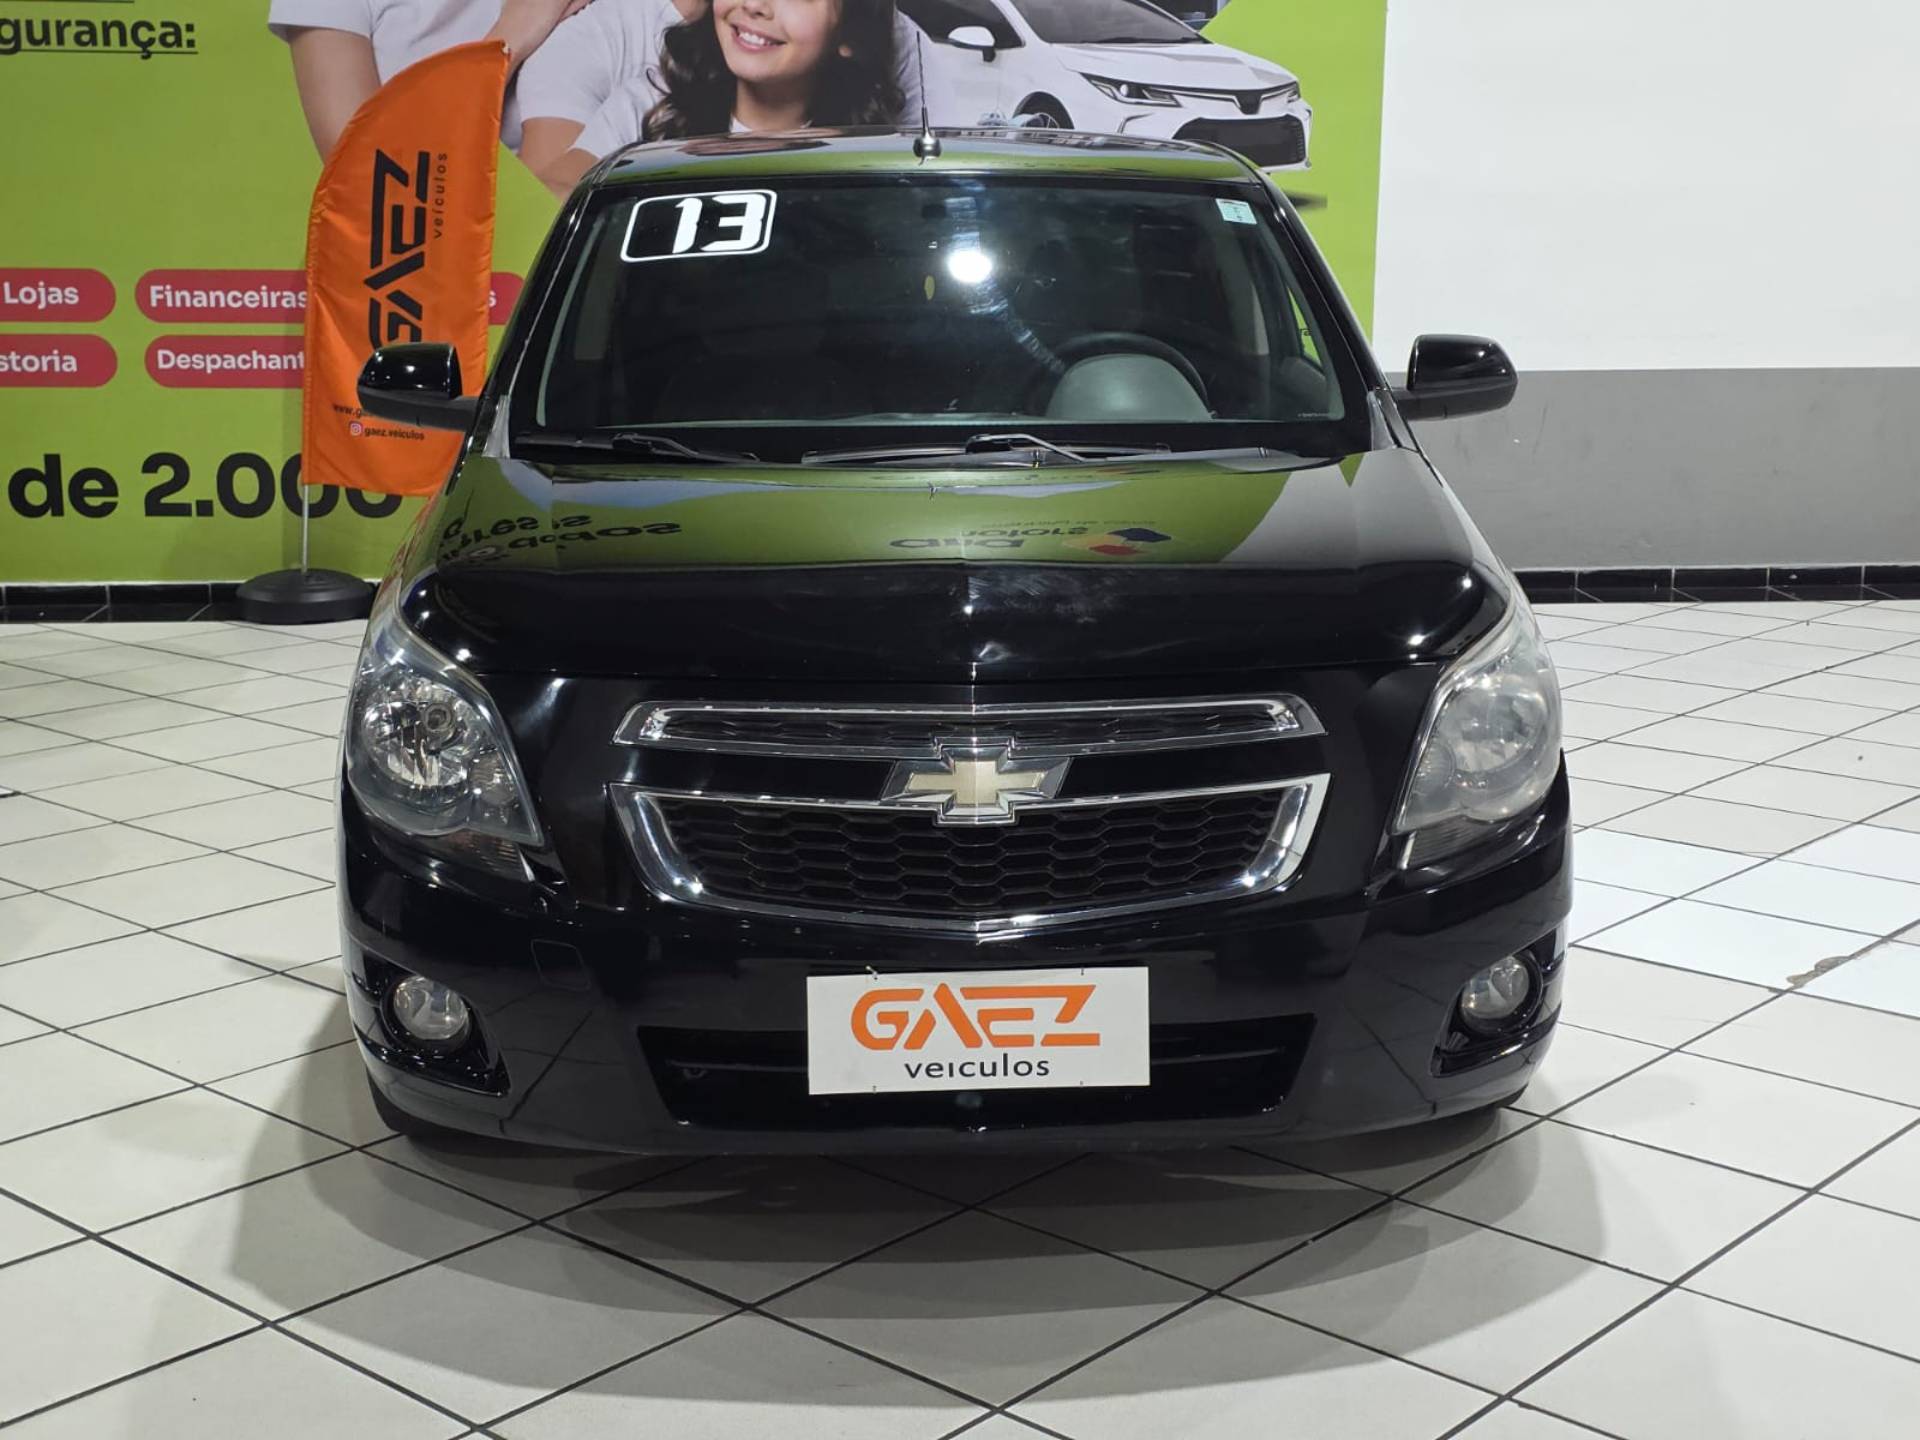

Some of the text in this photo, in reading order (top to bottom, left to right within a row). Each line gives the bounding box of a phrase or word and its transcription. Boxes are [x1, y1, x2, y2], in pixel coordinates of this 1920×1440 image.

[364, 148, 430, 351] GAEZ
[672, 193, 767, 254] 13
[4, 281, 80, 309] Lojas
[150, 285, 307, 308] Financeiras
[8, 453, 119, 518] de
[851, 982, 1100, 1051] GAEZ
